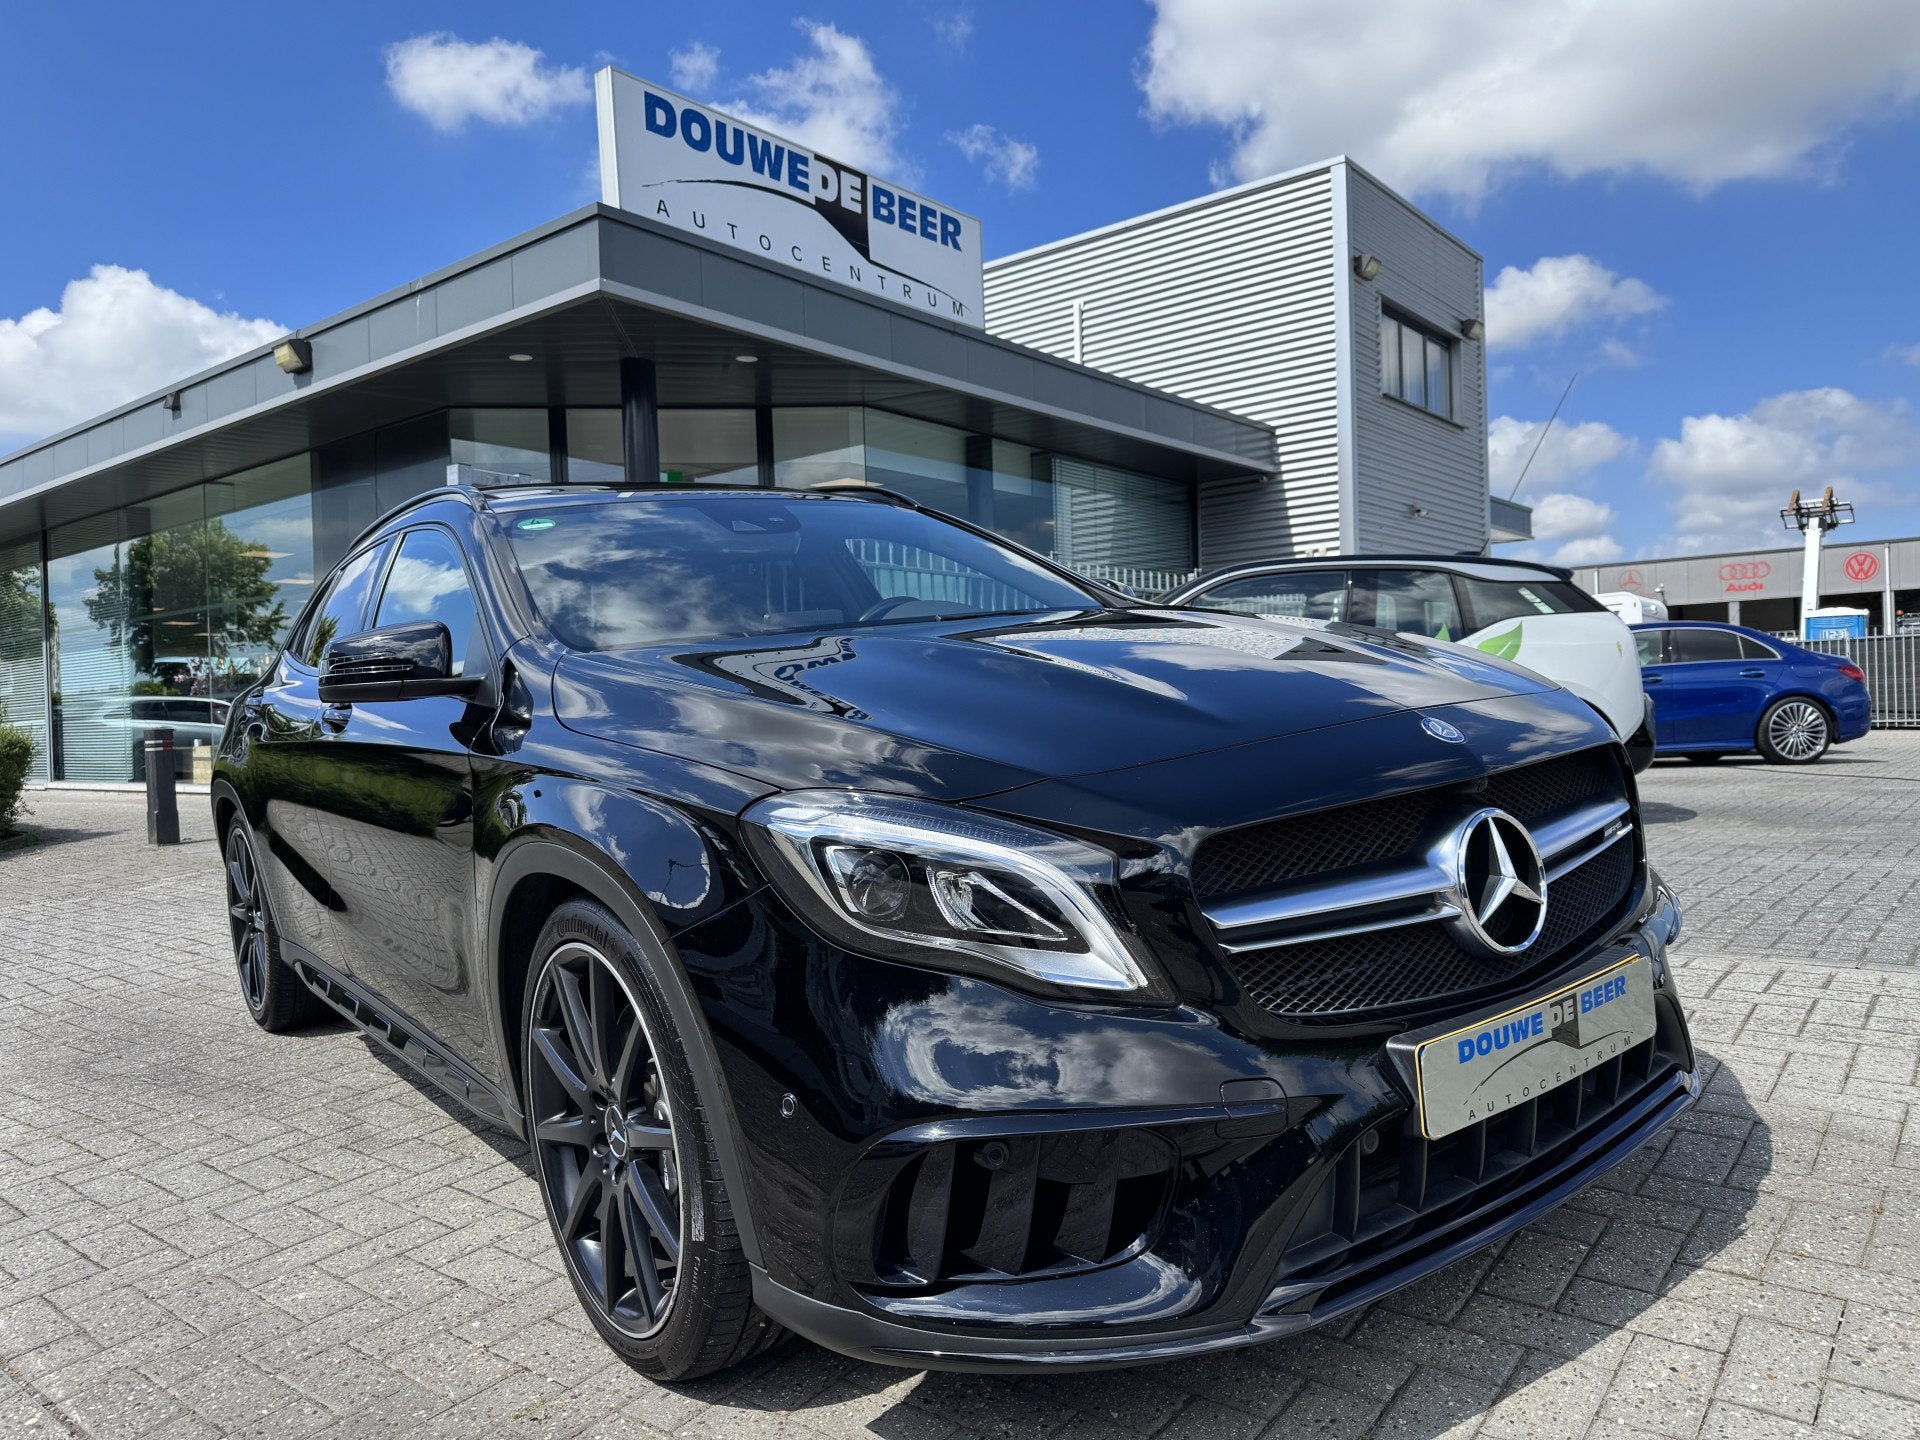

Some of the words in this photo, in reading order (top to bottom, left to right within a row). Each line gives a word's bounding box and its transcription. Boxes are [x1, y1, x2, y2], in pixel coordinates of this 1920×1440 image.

[643, 90, 810, 194] DOUWE
[813, 158, 863, 216] DE
[871, 183, 962, 252] BEER
[656, 199, 965, 318] AUTOCENTRUM
[1725, 582, 1764, 593] Audi
[556, 914, 609, 950] Continental
[1457, 1011, 1544, 1064] DOUWE
[1551, 1000, 1575, 1028] DE
[1581, 975, 1626, 1014] BEER
[1468, 1035, 1632, 1121] AUTOCENTRUM
